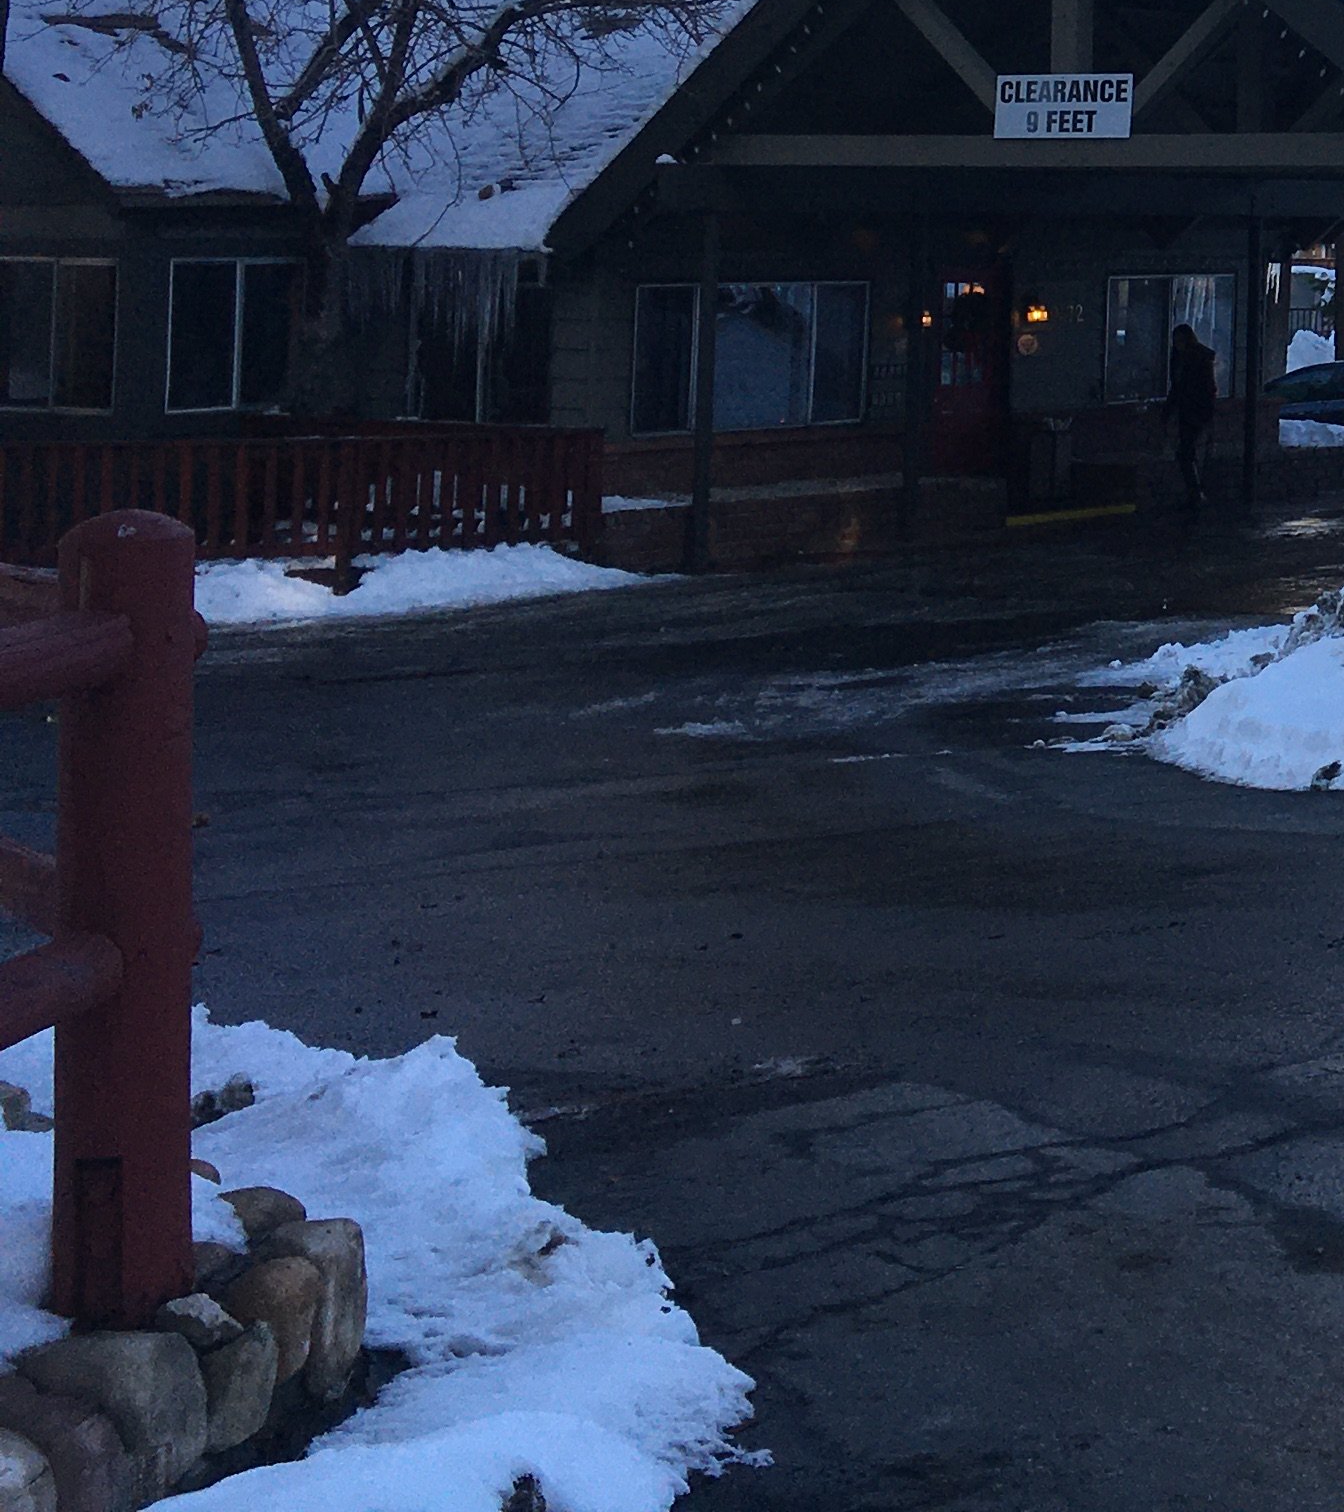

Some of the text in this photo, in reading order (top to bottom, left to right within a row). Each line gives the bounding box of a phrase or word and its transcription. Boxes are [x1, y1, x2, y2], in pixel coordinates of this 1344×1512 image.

[1000, 79, 1129, 104] CLEARANCE
[1026, 110, 1098, 134] 9 FEET
